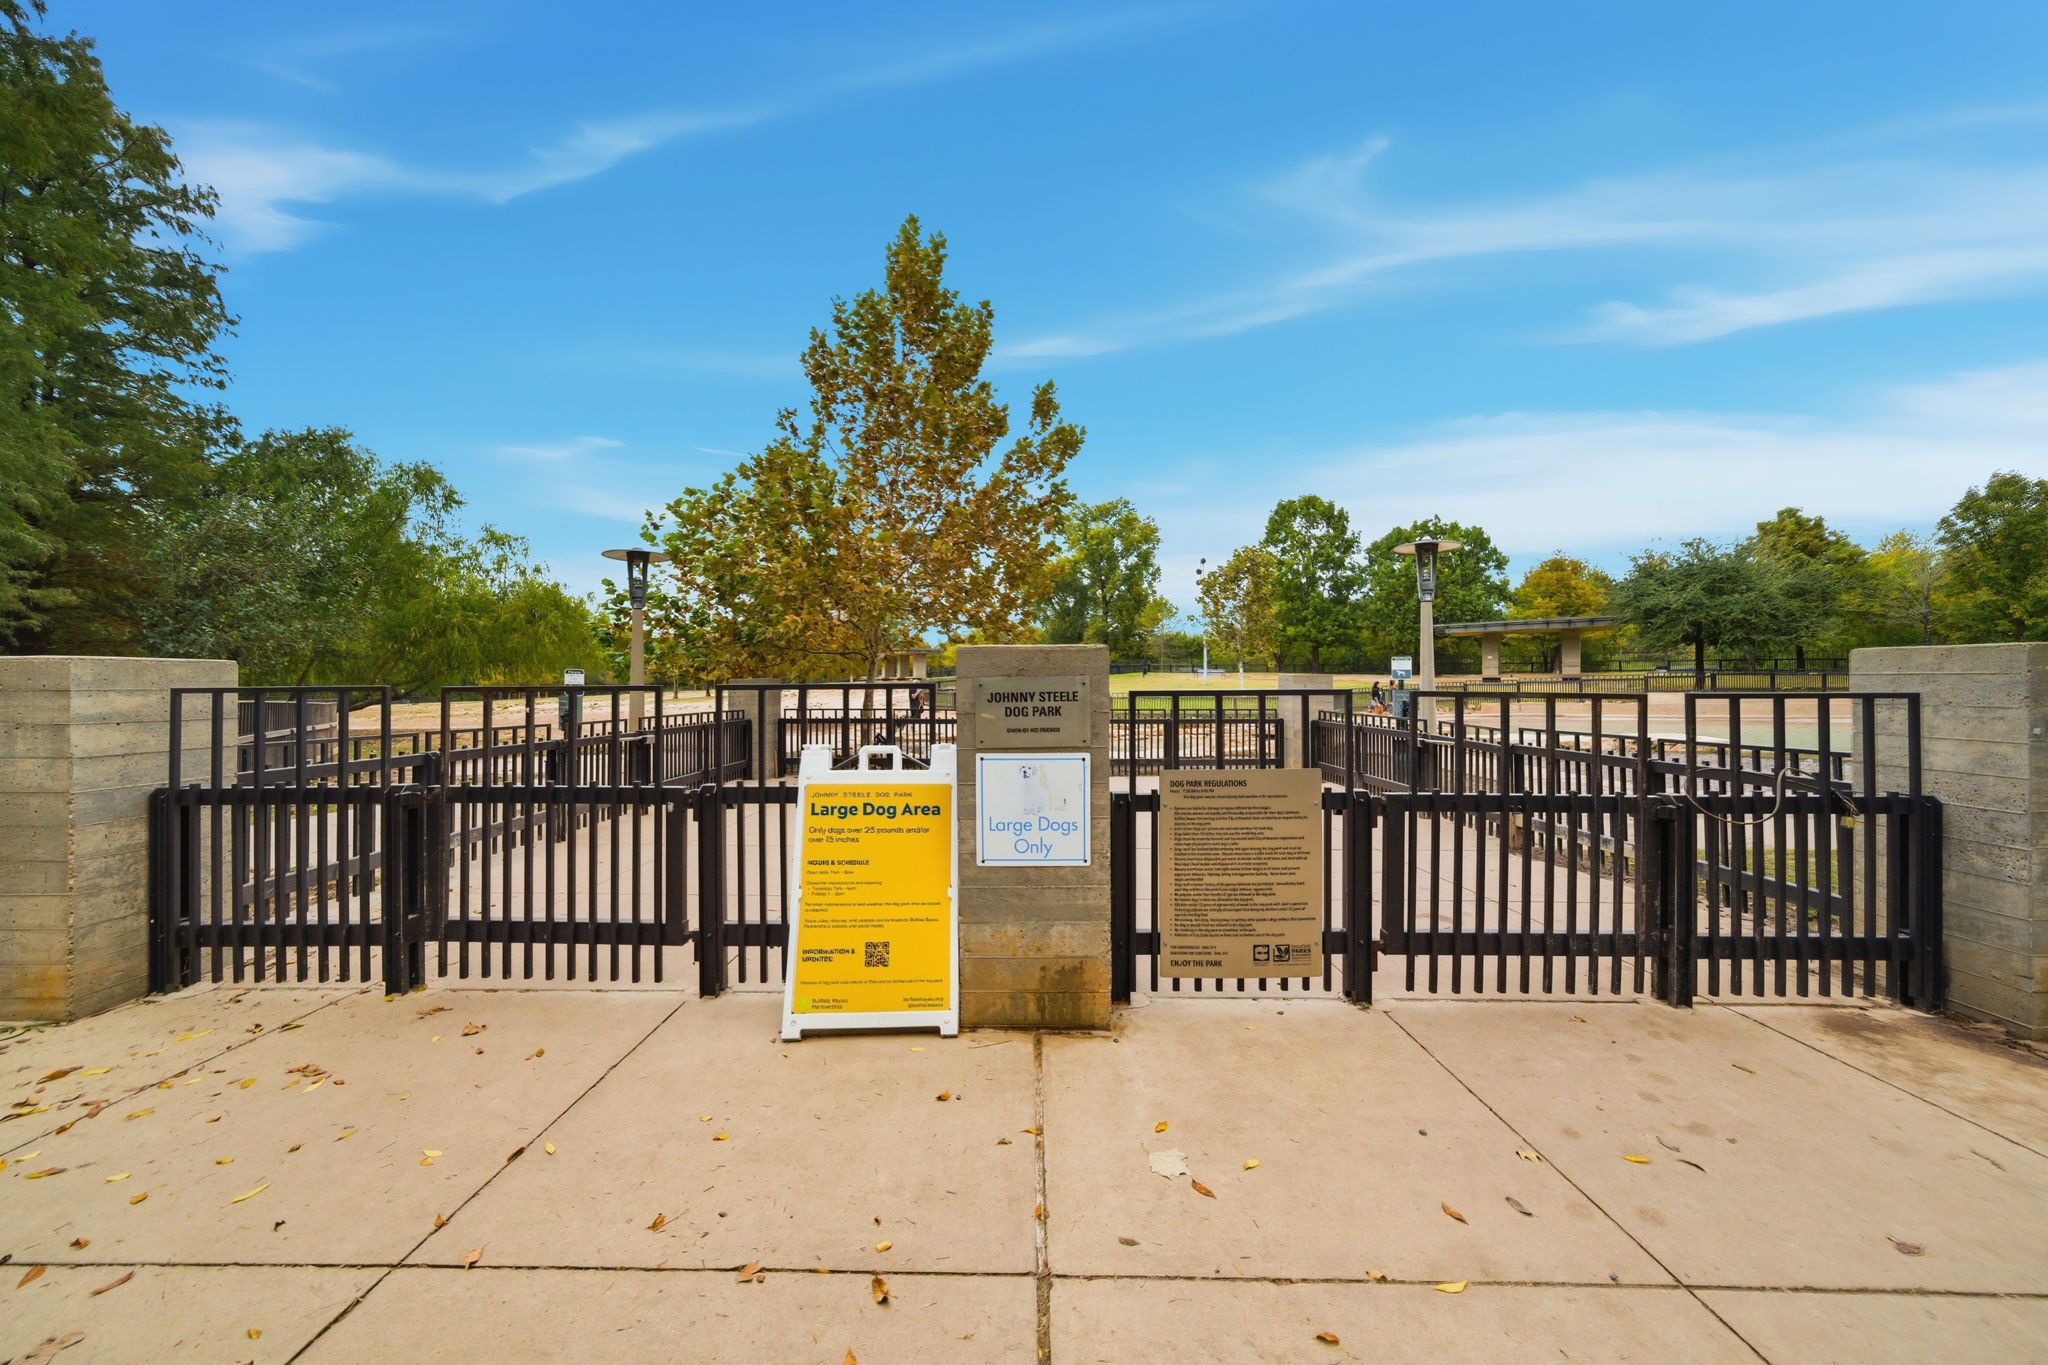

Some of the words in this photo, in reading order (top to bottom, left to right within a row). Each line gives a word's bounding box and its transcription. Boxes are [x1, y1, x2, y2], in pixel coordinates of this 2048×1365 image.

[987, 692, 1035, 703] JOHNNY
[1039, 691, 1079, 702] STEELE
[1004, 706, 1029, 717] DOG
[1032, 706, 1062, 717] PARK
[1170, 780, 1184, 788] DOG
[1186, 780, 1202, 788] PARK
[1204, 779, 1247, 787] REGULATIONS
[810, 802, 858, 819] Large
[862, 802, 897, 819] Dog
[900, 803, 941, 816] Area
[808, 826, 827, 835] Only
[827, 826, 846, 835] dogs
[876, 826, 904, 834] pounds
[989, 816, 1032, 836] Large
[1038, 816, 1078, 836] Dogs
[1014, 837, 1053, 858] Only
